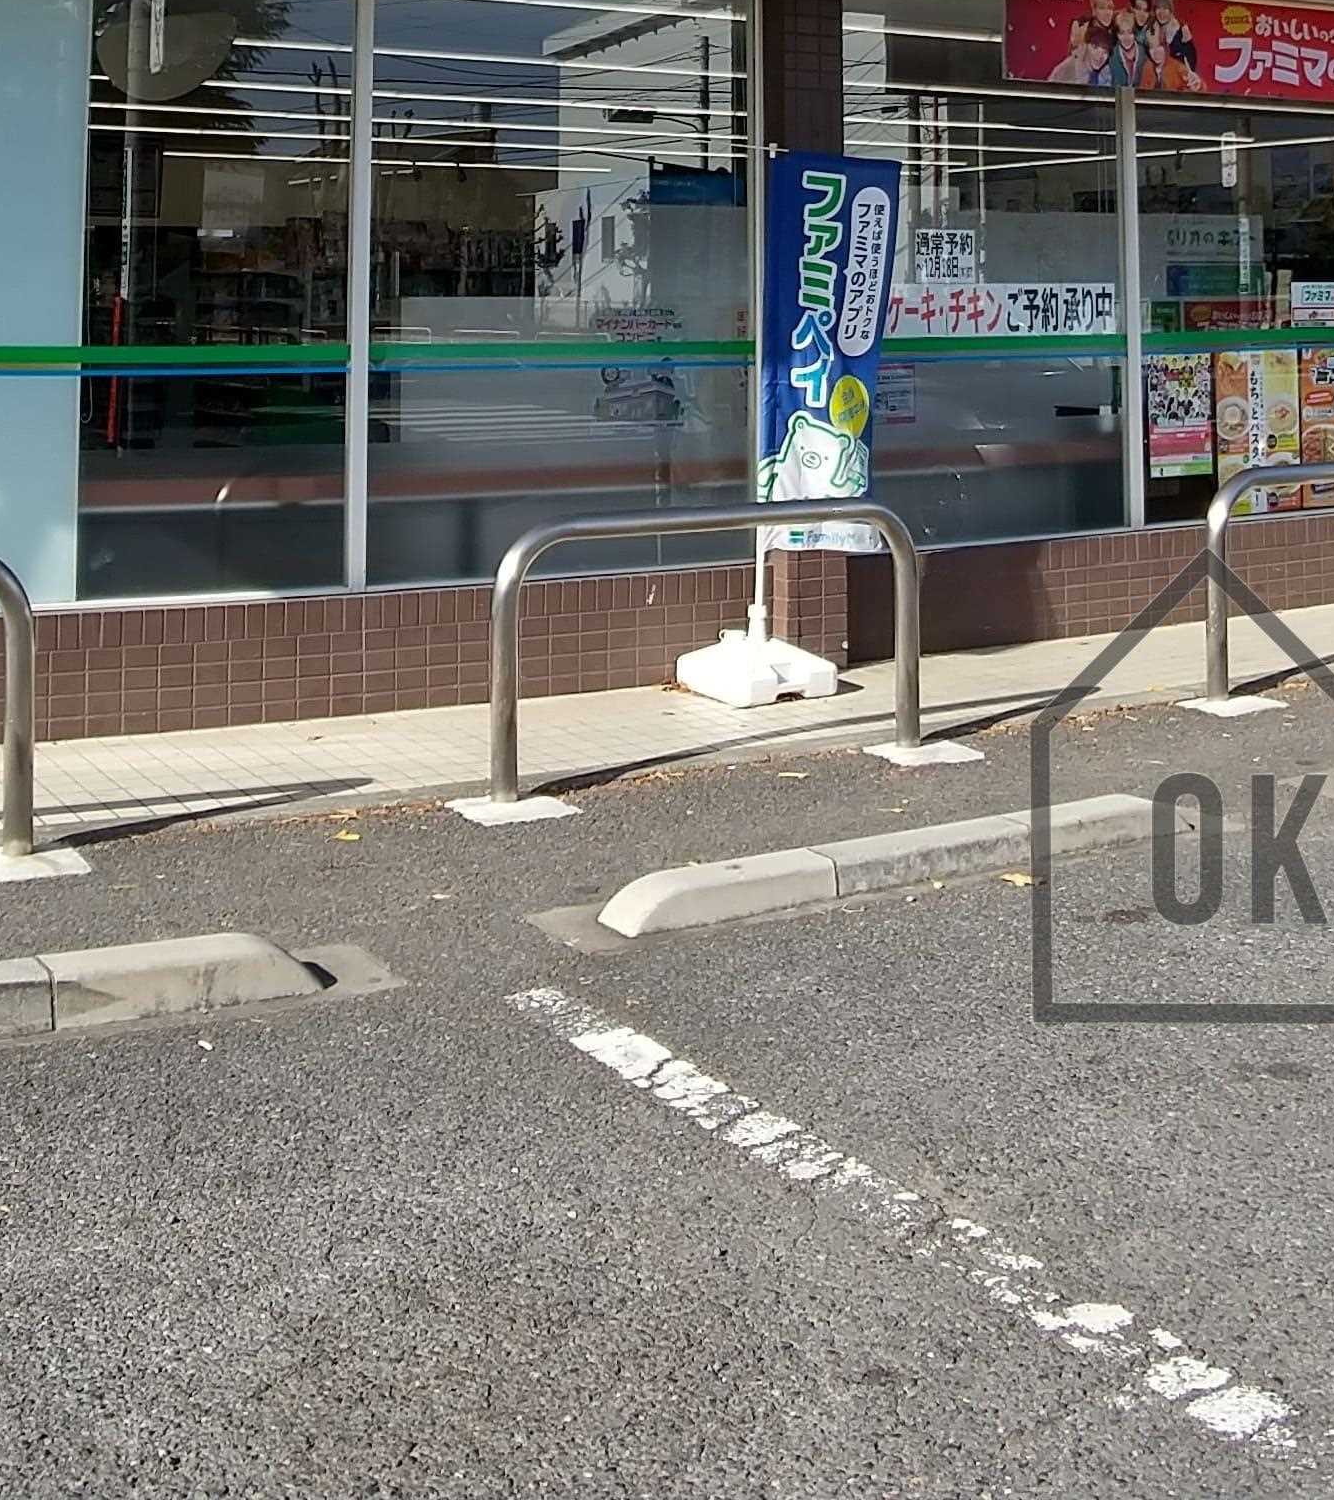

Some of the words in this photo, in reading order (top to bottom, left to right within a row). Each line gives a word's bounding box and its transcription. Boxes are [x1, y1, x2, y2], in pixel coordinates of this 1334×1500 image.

[790, 170, 846, 408] ファミペイ
[844, 202, 871, 341] ファミマのアプリ
[916, 232, 973, 256] 通常予約
